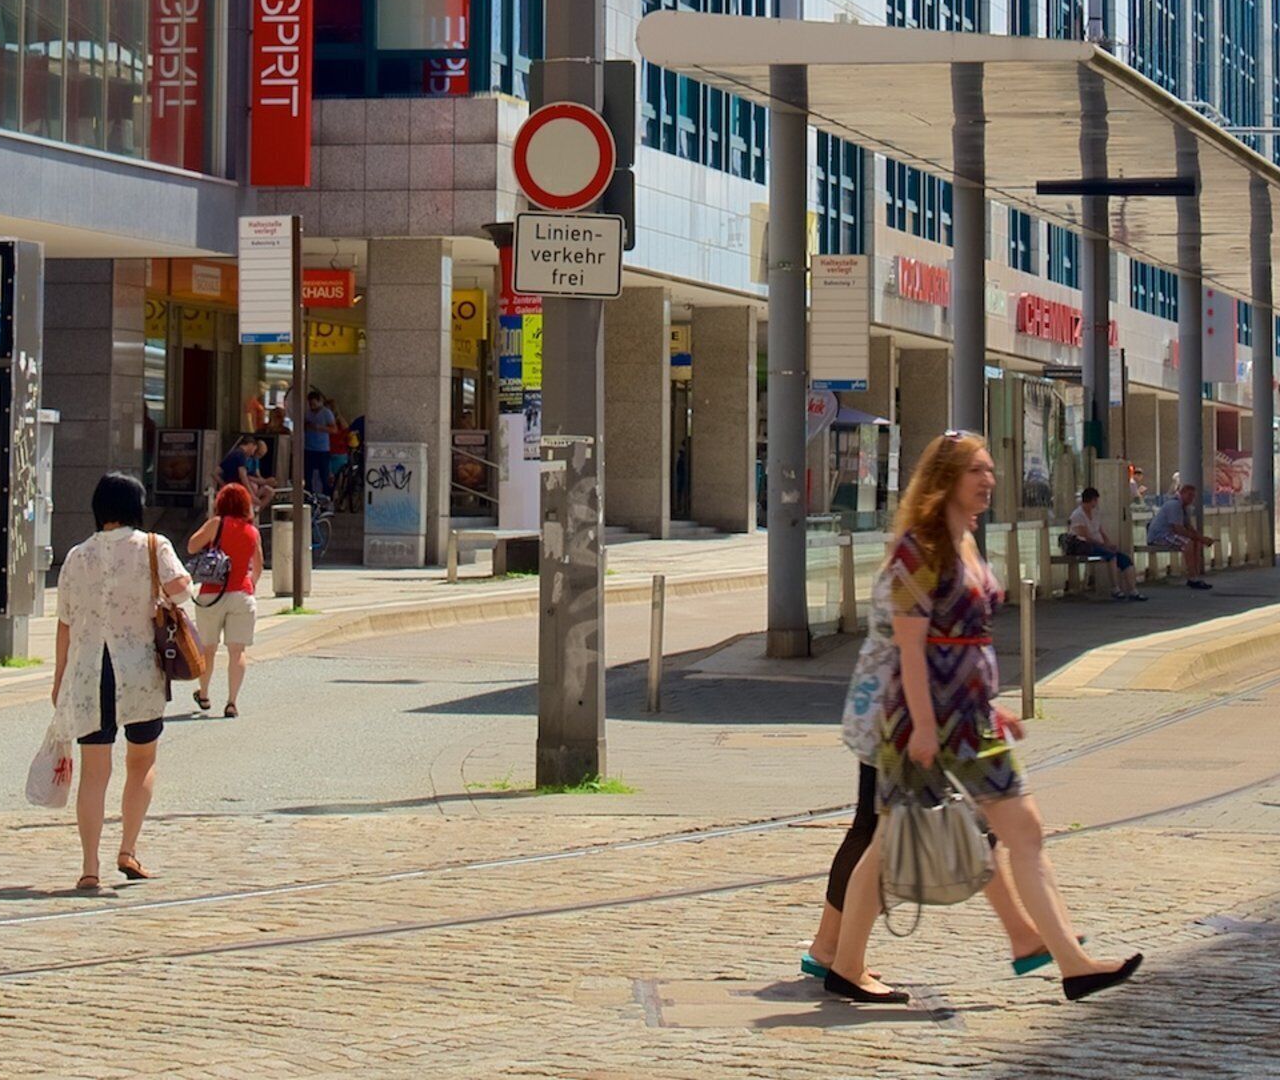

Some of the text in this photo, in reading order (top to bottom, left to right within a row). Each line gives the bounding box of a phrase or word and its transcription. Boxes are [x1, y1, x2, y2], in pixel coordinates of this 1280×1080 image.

[535, 223, 603, 242] Linien-
[531, 247, 606, 265] verkehr
[551, 270, 585, 286] frei
